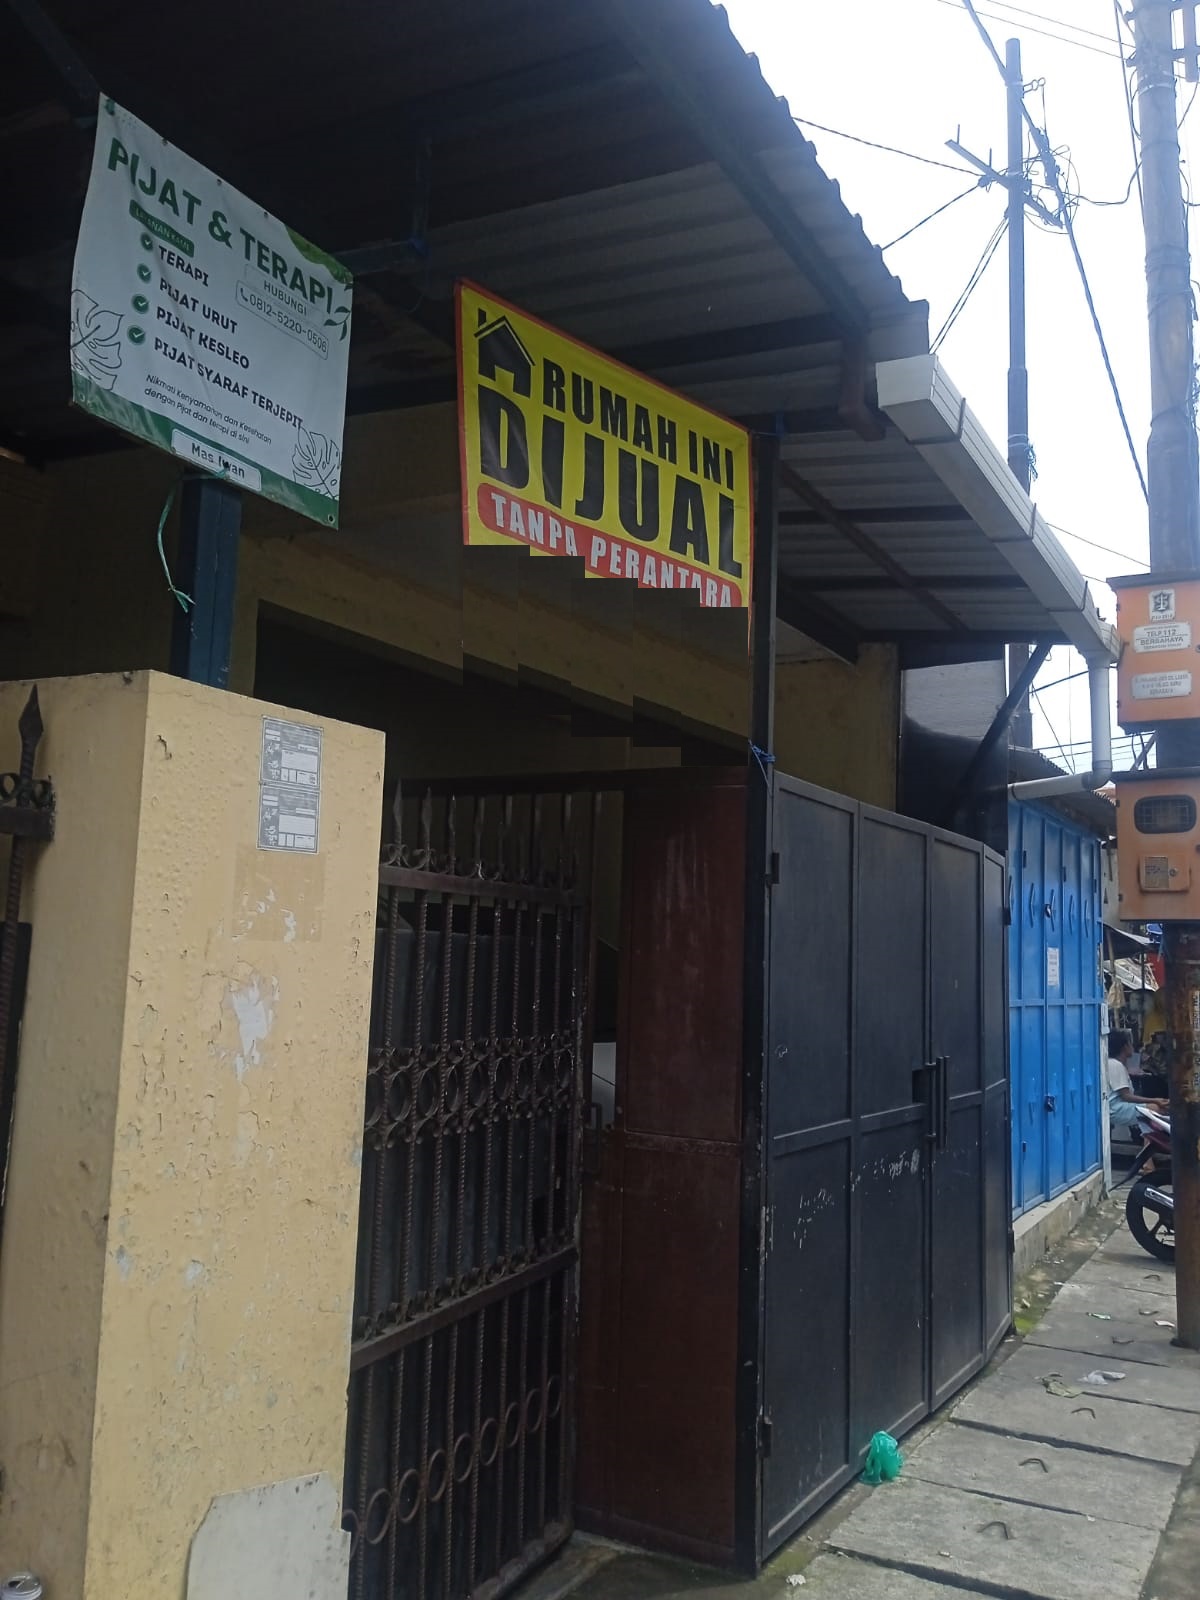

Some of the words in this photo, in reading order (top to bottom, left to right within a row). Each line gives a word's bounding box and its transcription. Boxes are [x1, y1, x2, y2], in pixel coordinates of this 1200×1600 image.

[108, 137, 202, 225] PIJAT
[207, 210, 232, 249] &
[240, 227, 333, 315] TERAPI
[158, 245, 209, 287] TERAPI
[159, 278, 199, 313] PIJAT
[203, 304, 238, 334] URUT
[249, 294, 327, 353] 0812-5220-0506
[263, 280, 307, 316] HUBUNGI
[157, 306, 195, 340] PIJAT
[199, 332, 250, 369] KESLEO
[146, 374, 175, 393] Nikmati
[224, 414, 238, 426] dan
[154, 337, 195, 369] PIJAT
[197, 363, 249, 399] SYARAF
[252, 391, 303, 431] TERJEPIT
[144, 387, 175, 406] dengan
[177, 402, 192, 416] Pijat
[193, 411, 207, 423] dan
[230, 428, 237, 438] di
[239, 434, 249, 444] sini
[543, 356, 677, 465] RUMAH
[688, 429, 734, 491] INI
[191, 442, 214, 463] Mas
[218, 456, 245, 478] Iwan
[478, 384, 742, 579] DIJUAL
[491, 492, 579, 557] TANPA
[590, 535, 732, 607] PERANTARA
